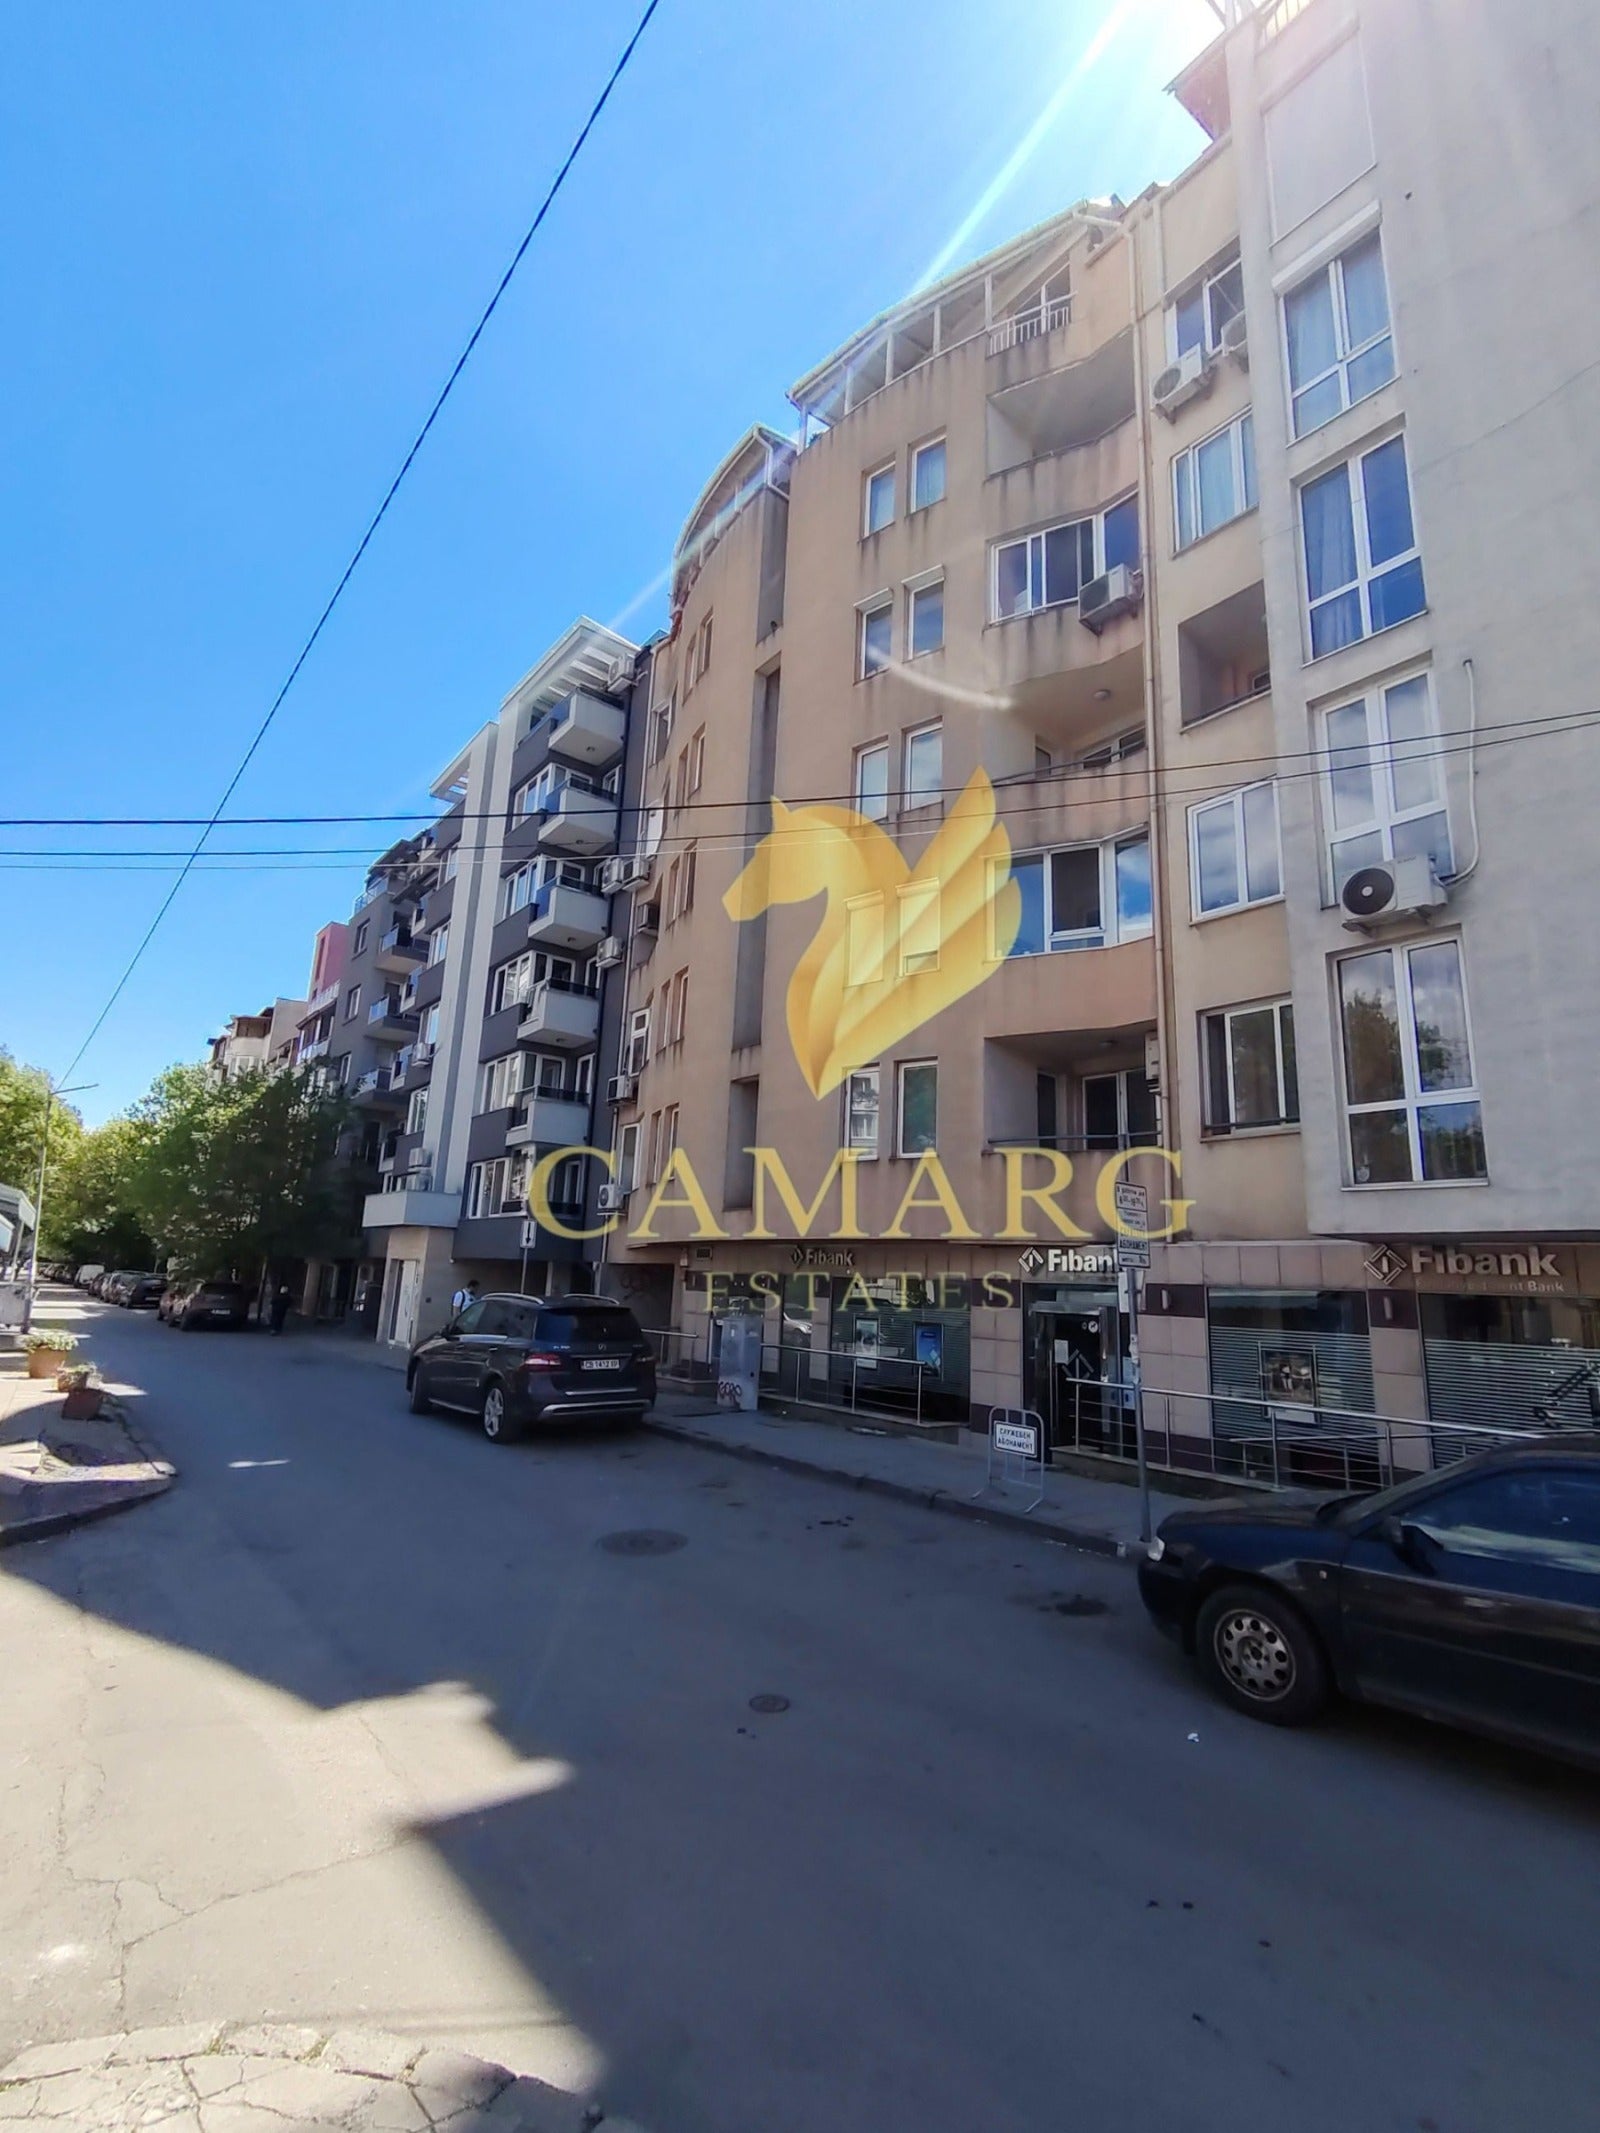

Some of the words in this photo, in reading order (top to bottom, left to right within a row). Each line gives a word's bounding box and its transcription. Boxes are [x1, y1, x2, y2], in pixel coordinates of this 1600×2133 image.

[805, 1248, 855, 1267] Fibank
[1411, 1245, 1561, 1277] Fibank
[1527, 1280, 1565, 1293] Bank
